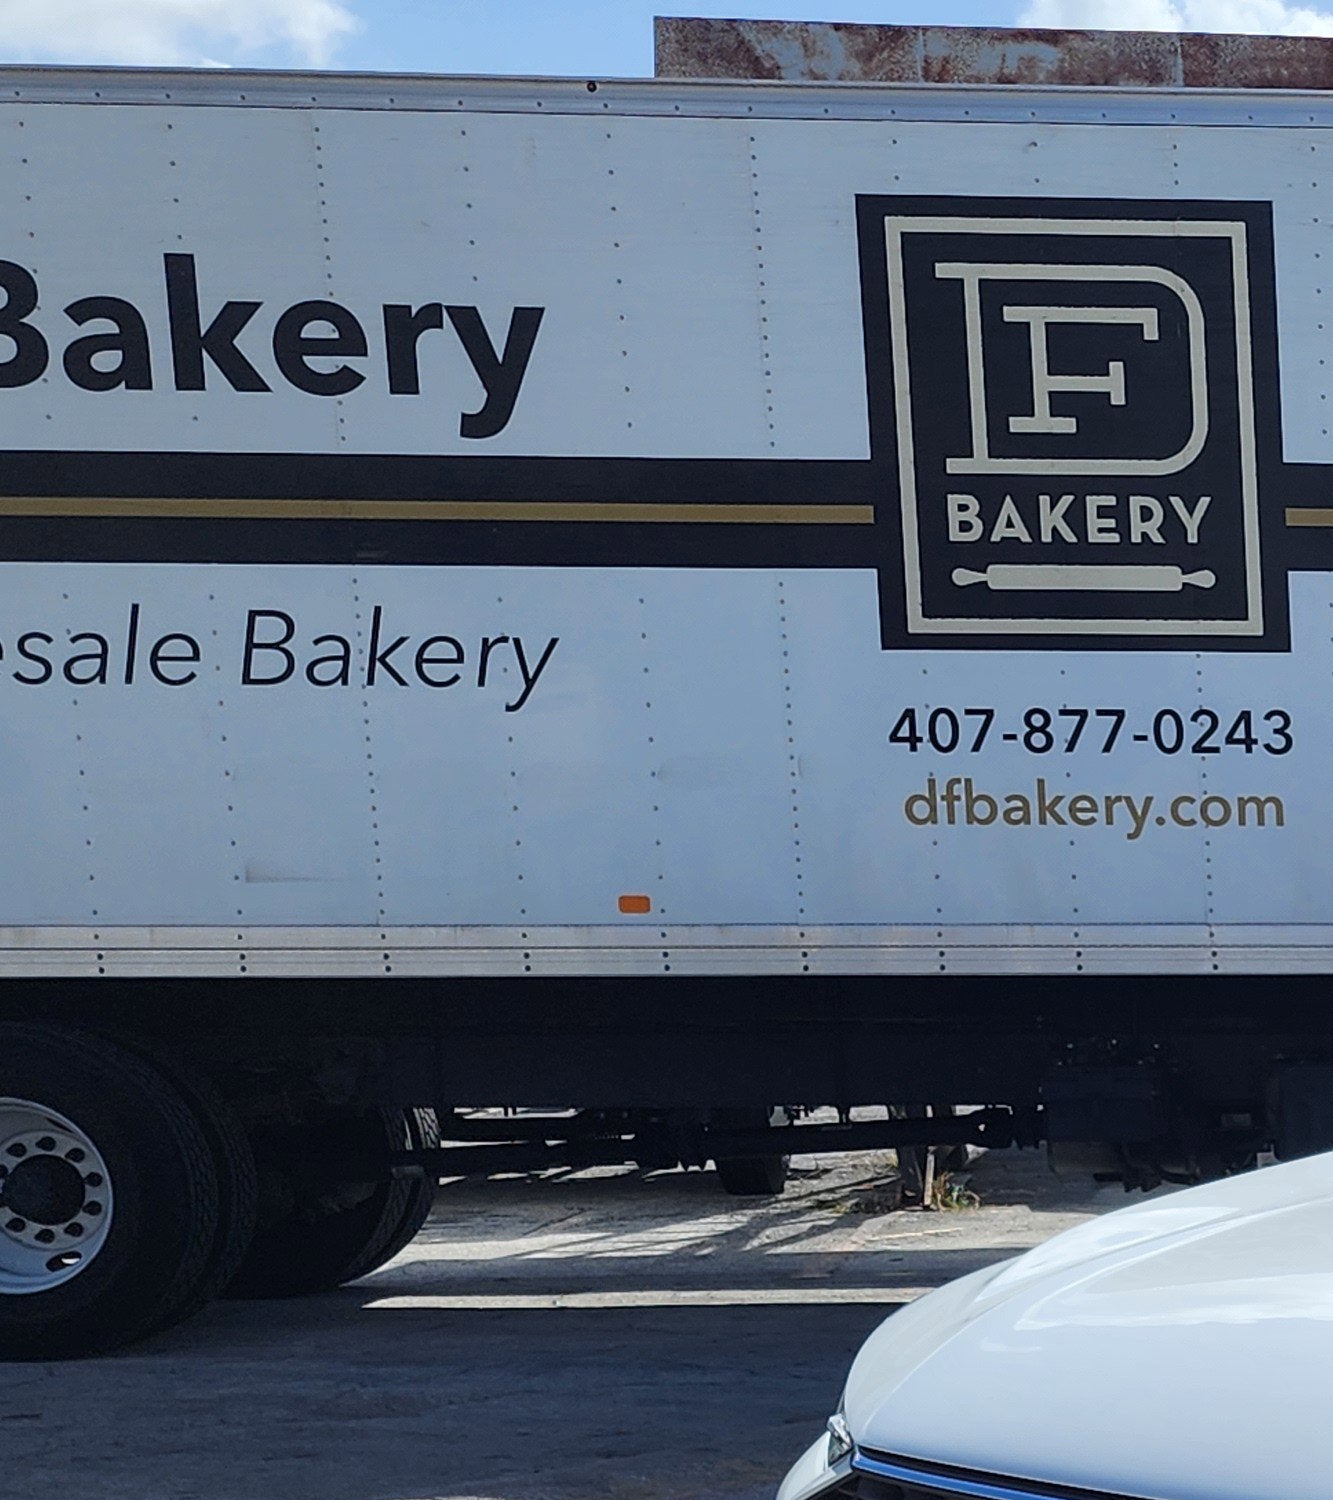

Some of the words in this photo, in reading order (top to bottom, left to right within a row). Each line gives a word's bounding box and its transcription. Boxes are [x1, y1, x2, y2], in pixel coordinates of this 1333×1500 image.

[0, 253, 546, 440] Bakery
[946, 493, 1212, 544] BAKERY
[0, 603, 201, 686] sale
[241, 605, 560, 713] Bakery
[888, 707, 1294, 756] 407-877-0243
[904, 777, 1286, 841] dfbakery.com
